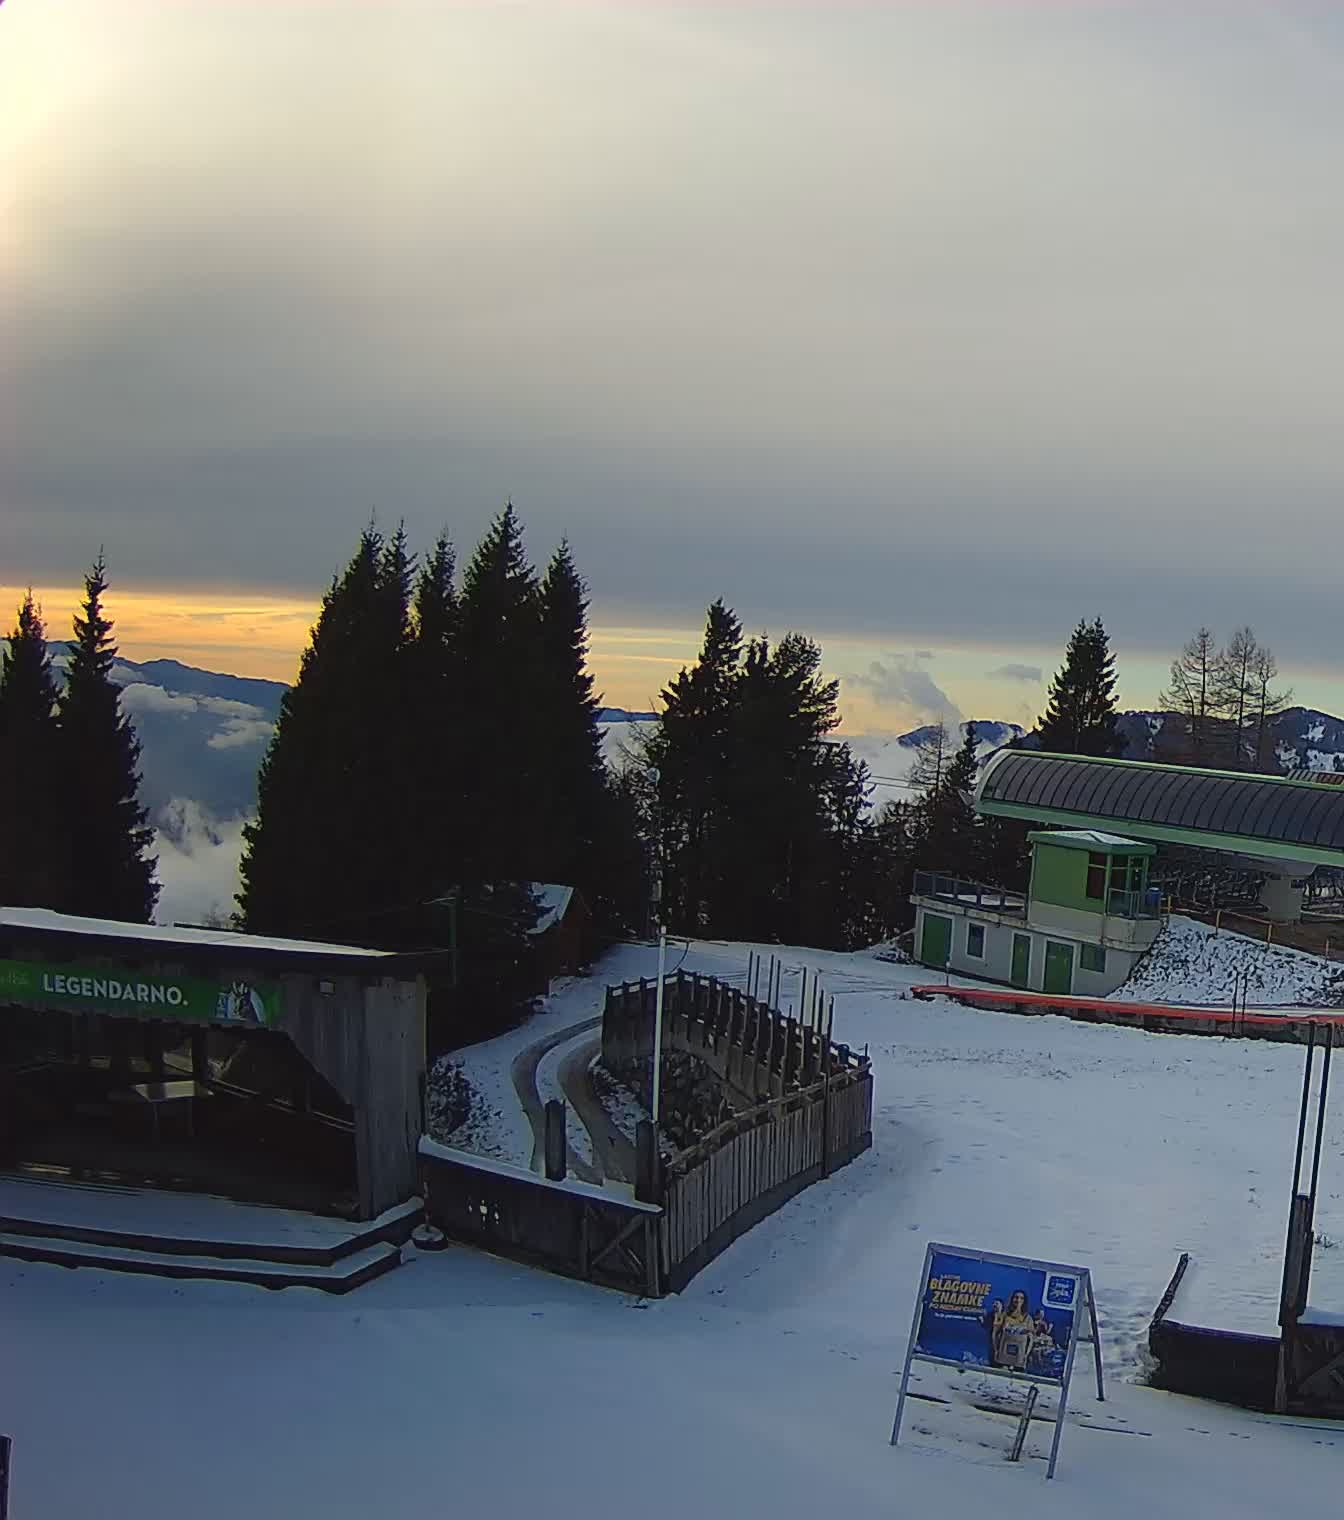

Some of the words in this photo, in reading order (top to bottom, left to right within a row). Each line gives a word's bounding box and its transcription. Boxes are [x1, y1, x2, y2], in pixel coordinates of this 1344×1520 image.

[43, 973, 188, 1006] LEGENDARNO.
[930, 1278, 992, 1296] BLAGOVNE
[932, 1291, 985, 1307] ZNAMKE
